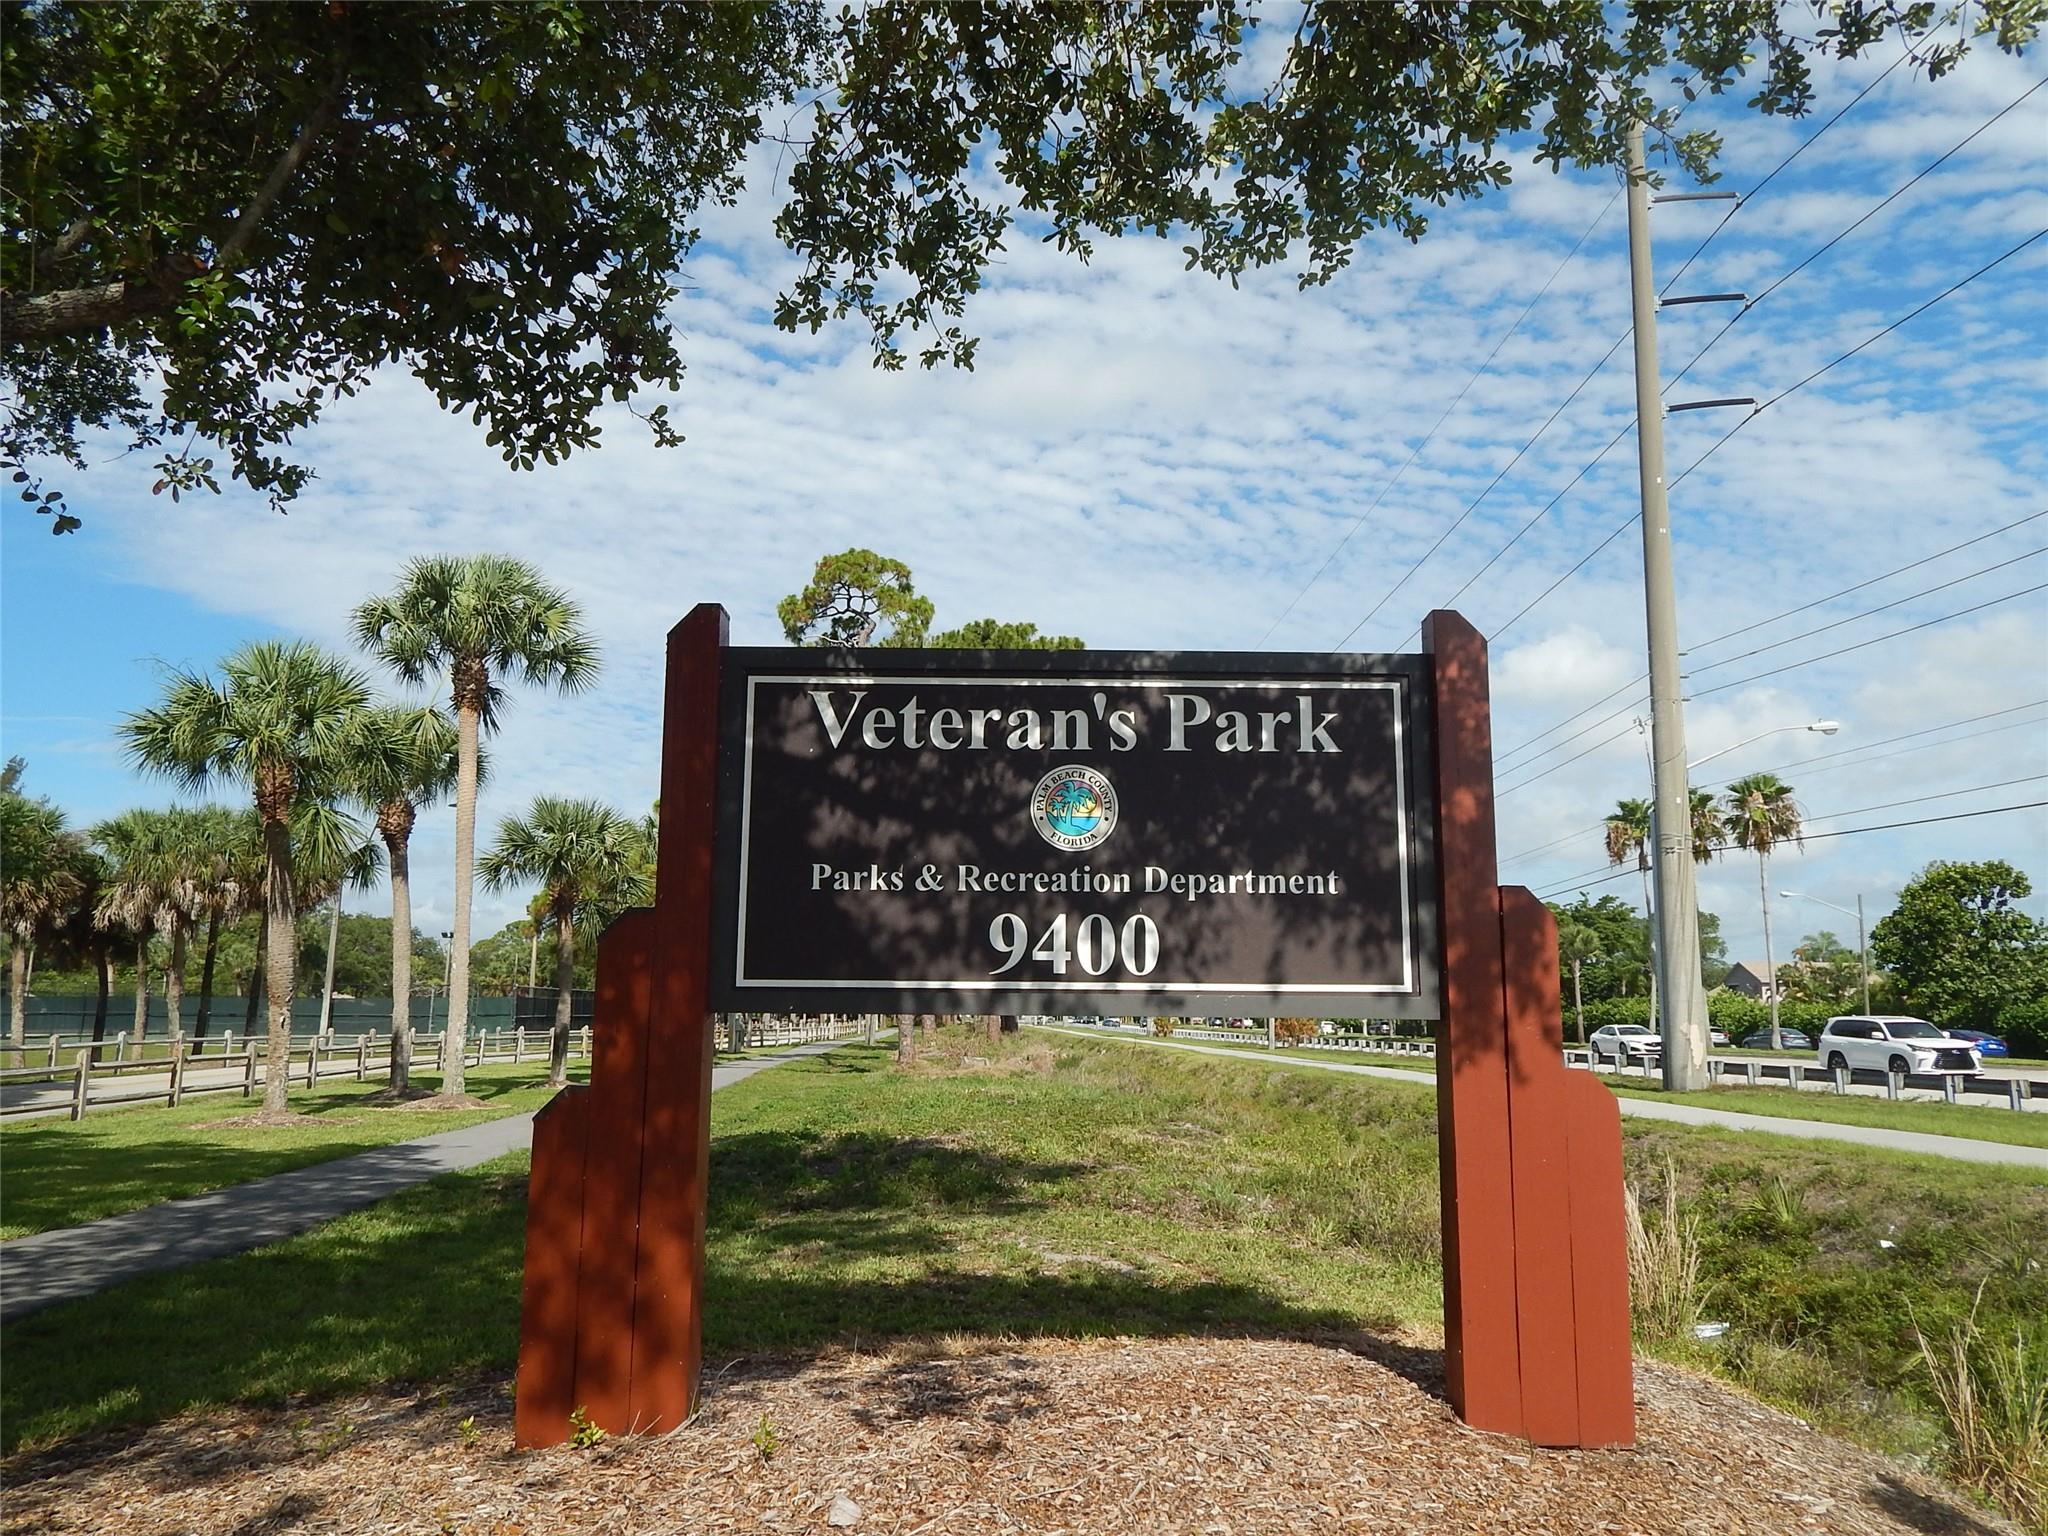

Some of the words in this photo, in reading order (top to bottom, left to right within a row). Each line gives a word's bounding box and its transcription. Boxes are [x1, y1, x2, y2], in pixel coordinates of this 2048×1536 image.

[807, 689, 1137, 754] Veteran's
[1162, 693, 1343, 754] Park
[1036, 783, 1051, 812] PALM
[1051, 770, 1086, 784] BEACH
[1088, 775, 1113, 812] COUNTY
[1050, 831, 1098, 846] FLORIDA
[811, 863, 904, 893] Parks
[915, 864, 944, 892] &
[957, 864, 1130, 894] Recreation
[1144, 865, 1339, 901] Department
[988, 912, 1160, 977] 9400
